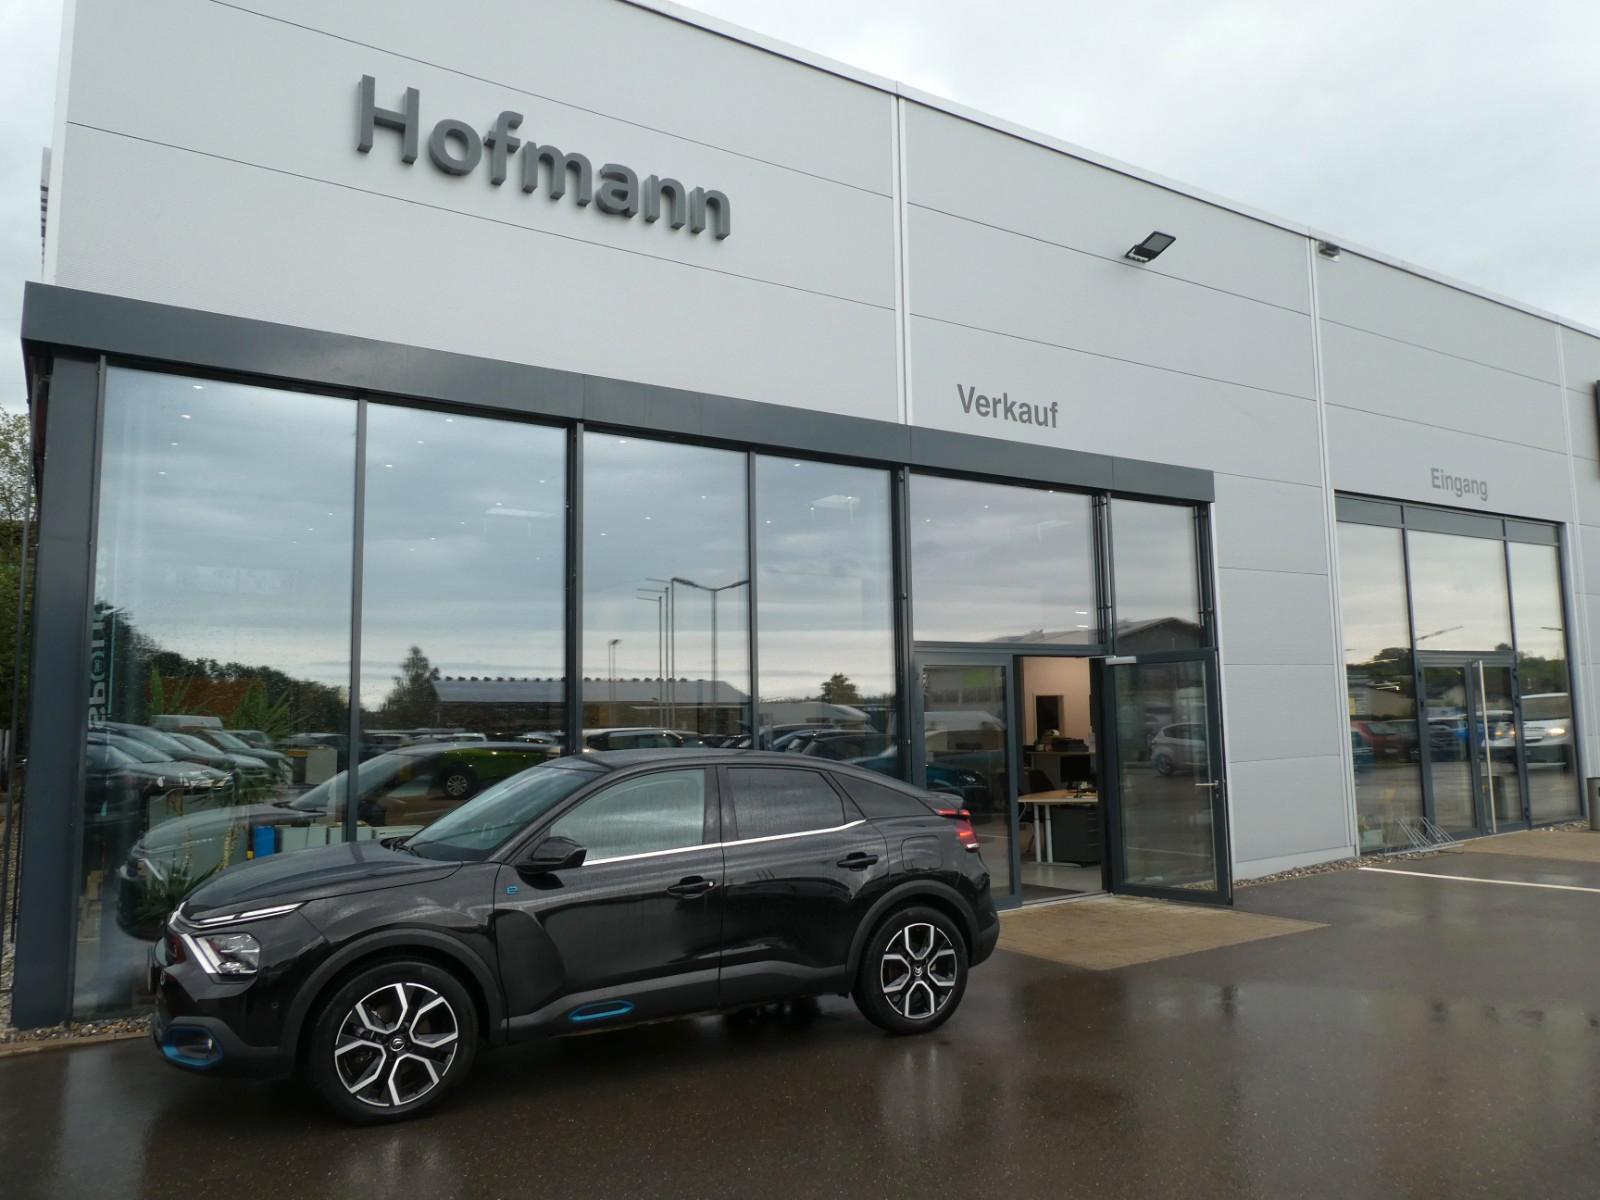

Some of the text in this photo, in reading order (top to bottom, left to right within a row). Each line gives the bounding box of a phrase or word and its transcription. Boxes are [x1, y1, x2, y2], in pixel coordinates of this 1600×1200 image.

[357, 74, 731, 240] Hofmann
[957, 383, 1059, 428] Verkauf
[1431, 467, 1489, 502] Eingang
